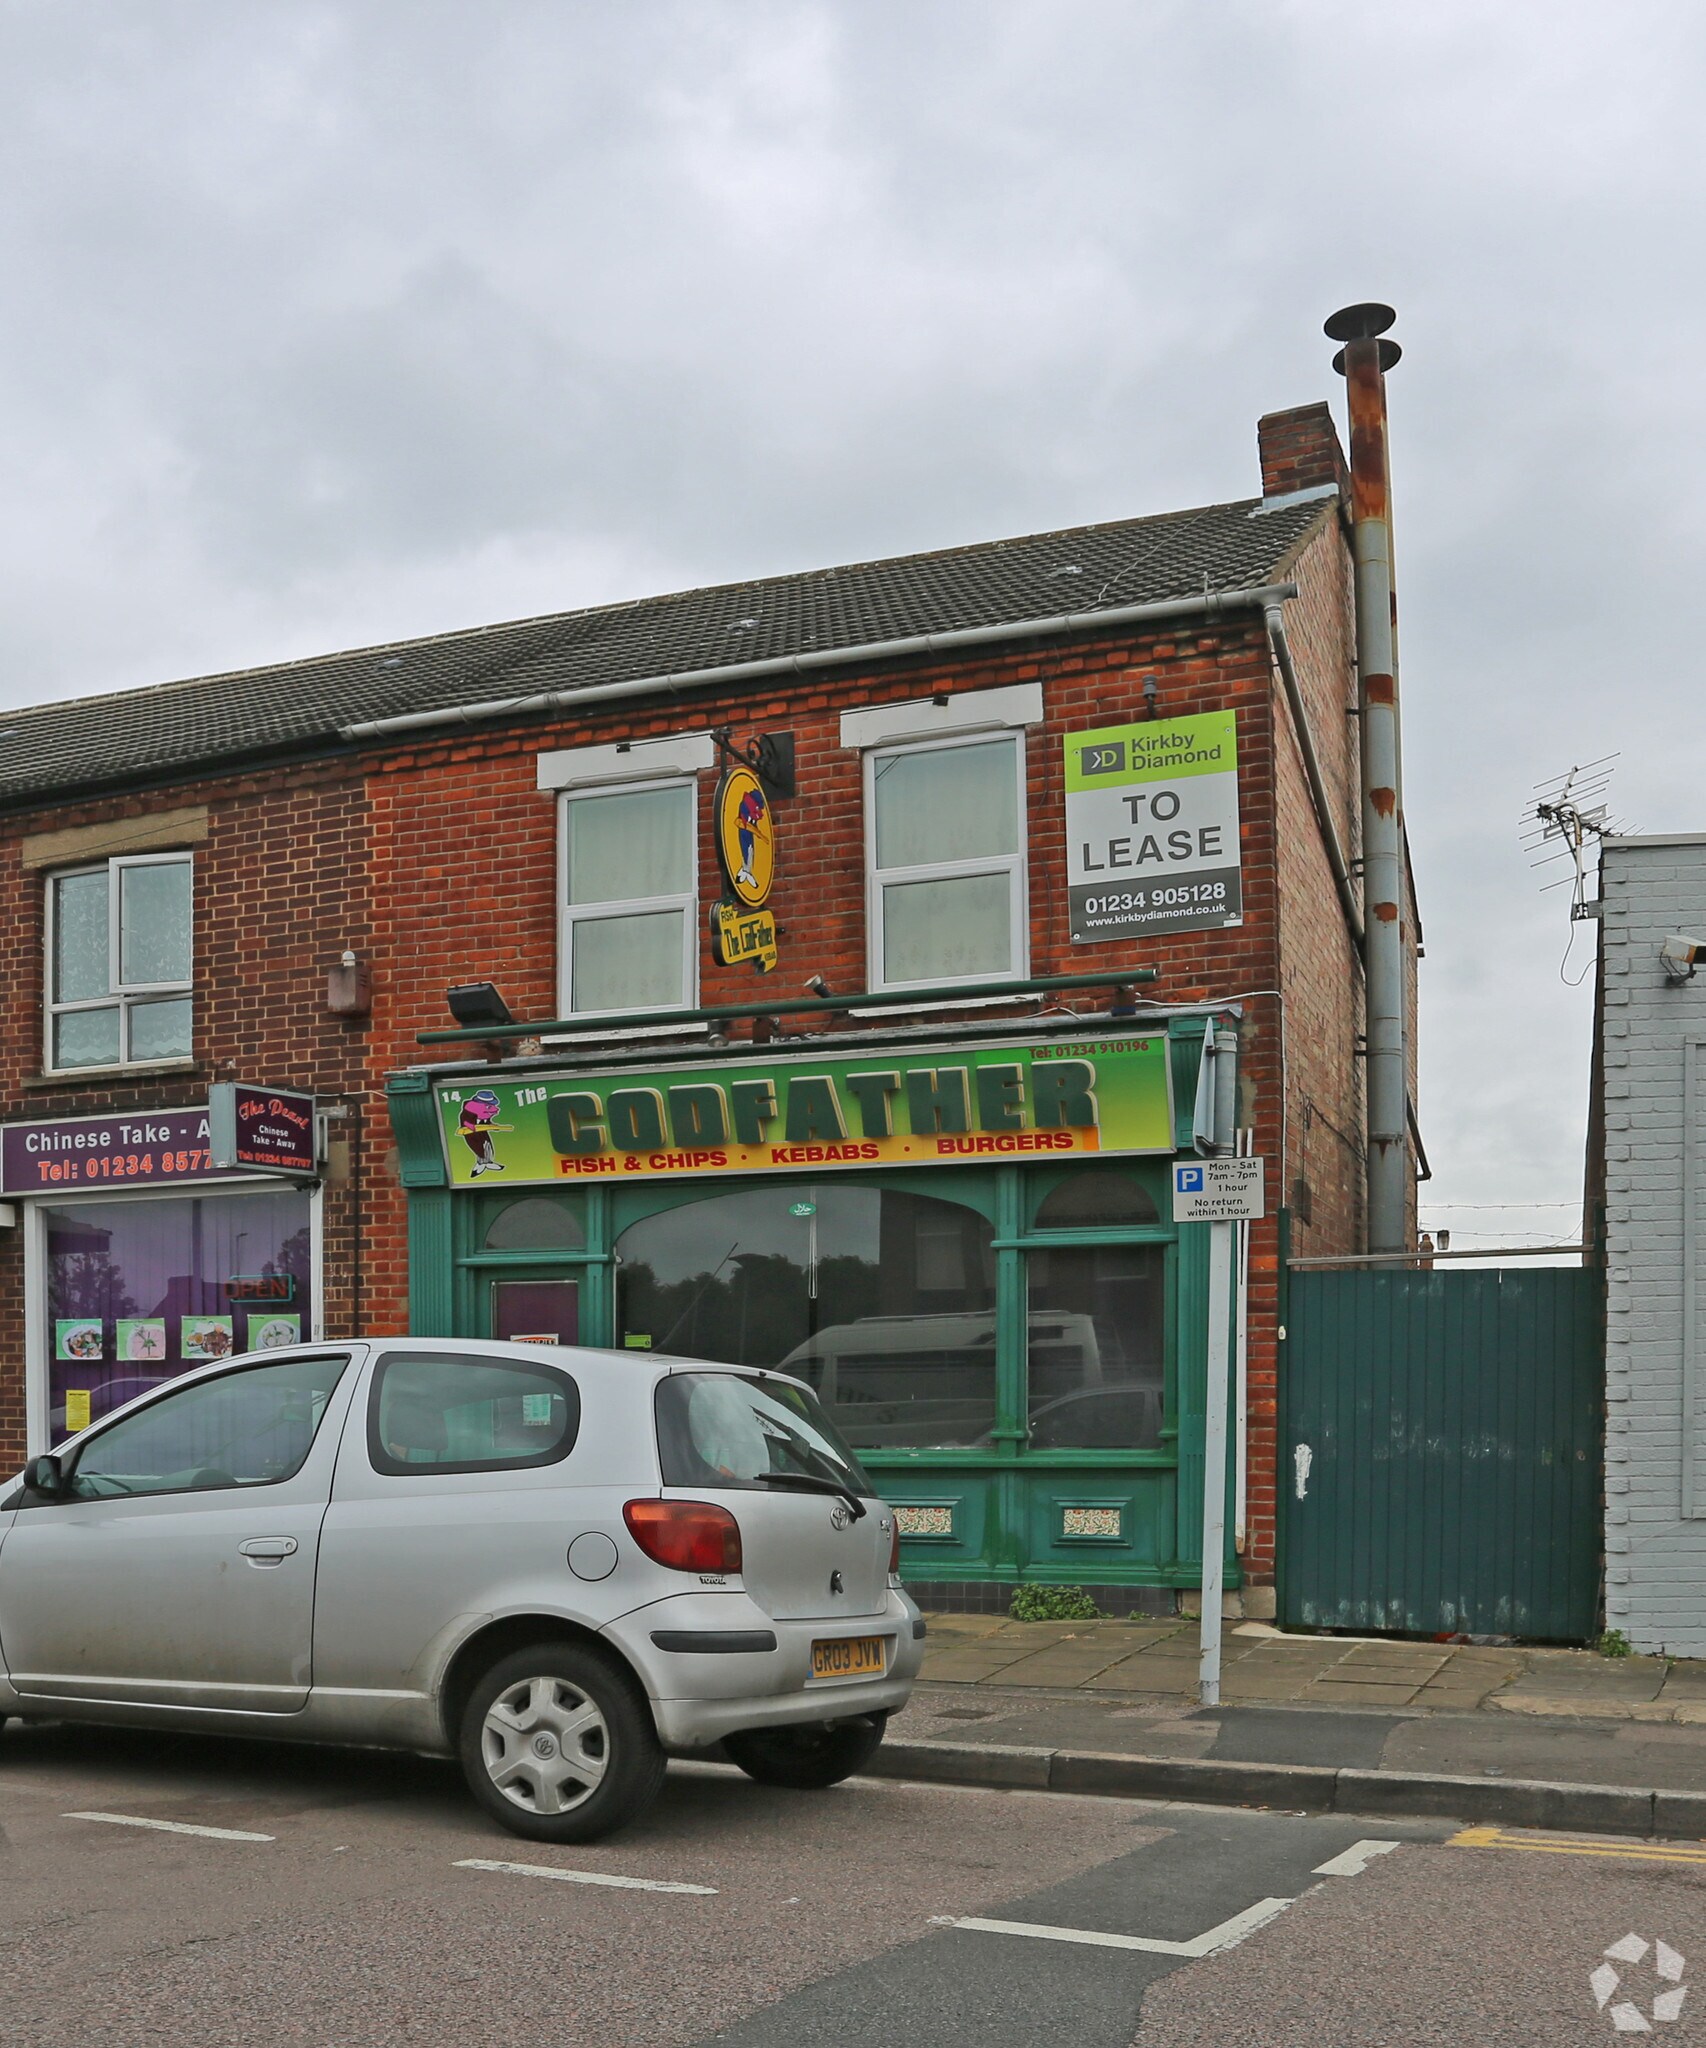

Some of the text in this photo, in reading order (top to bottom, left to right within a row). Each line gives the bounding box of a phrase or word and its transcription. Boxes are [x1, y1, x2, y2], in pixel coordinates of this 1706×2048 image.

[1131, 733, 1195, 753] Kirkby
[1132, 744, 1222, 771] Diamond
[1122, 791, 1181, 825] TO
[1083, 826, 1223, 872] LEASE
[1085, 882, 1226, 914] 01234 905128
[1086, 903, 1226, 928] www.kirkbydiamond.co.uk
[1029, 1040, 1149, 1059] Tel: 01234 910196
[442, 1090, 461, 1104] 14
[514, 1058, 1099, 1155] The CODFATHER
[239, 1100, 266, 1120] The
[25, 1129, 111, 1153] Chinese
[119, 1123, 171, 1146] Take
[259, 1124, 289, 1137] Chinese
[252, 1134, 270, 1146] Take
[276, 1138, 296, 1150] Away
[561, 1132, 1074, 1174] FISH & CHIPS KEBABS BURGERS
[38, 1149, 212, 1181] Tel: 01234 8577
[1209, 1163, 1230, 1171] Mon
[1239, 1161, 1257, 1169] Sat
[1182, 1170, 1198, 1190] P
[1208, 1173, 1228, 1181] 7am
[1237, 1171, 1258, 1180] 7pm
[1218, 1183, 1248, 1192] 1 hour
[794, 1203, 811, 1213] حلال
[1187, 1207, 1250, 1217] within 1 hour
[1195, 1198, 1243, 1207] No return
[224, 1279, 287, 1299] OPEN
[699, 1575, 726, 1585] TOYOTA
[814, 1640, 881, 1672] GR03 JVW
